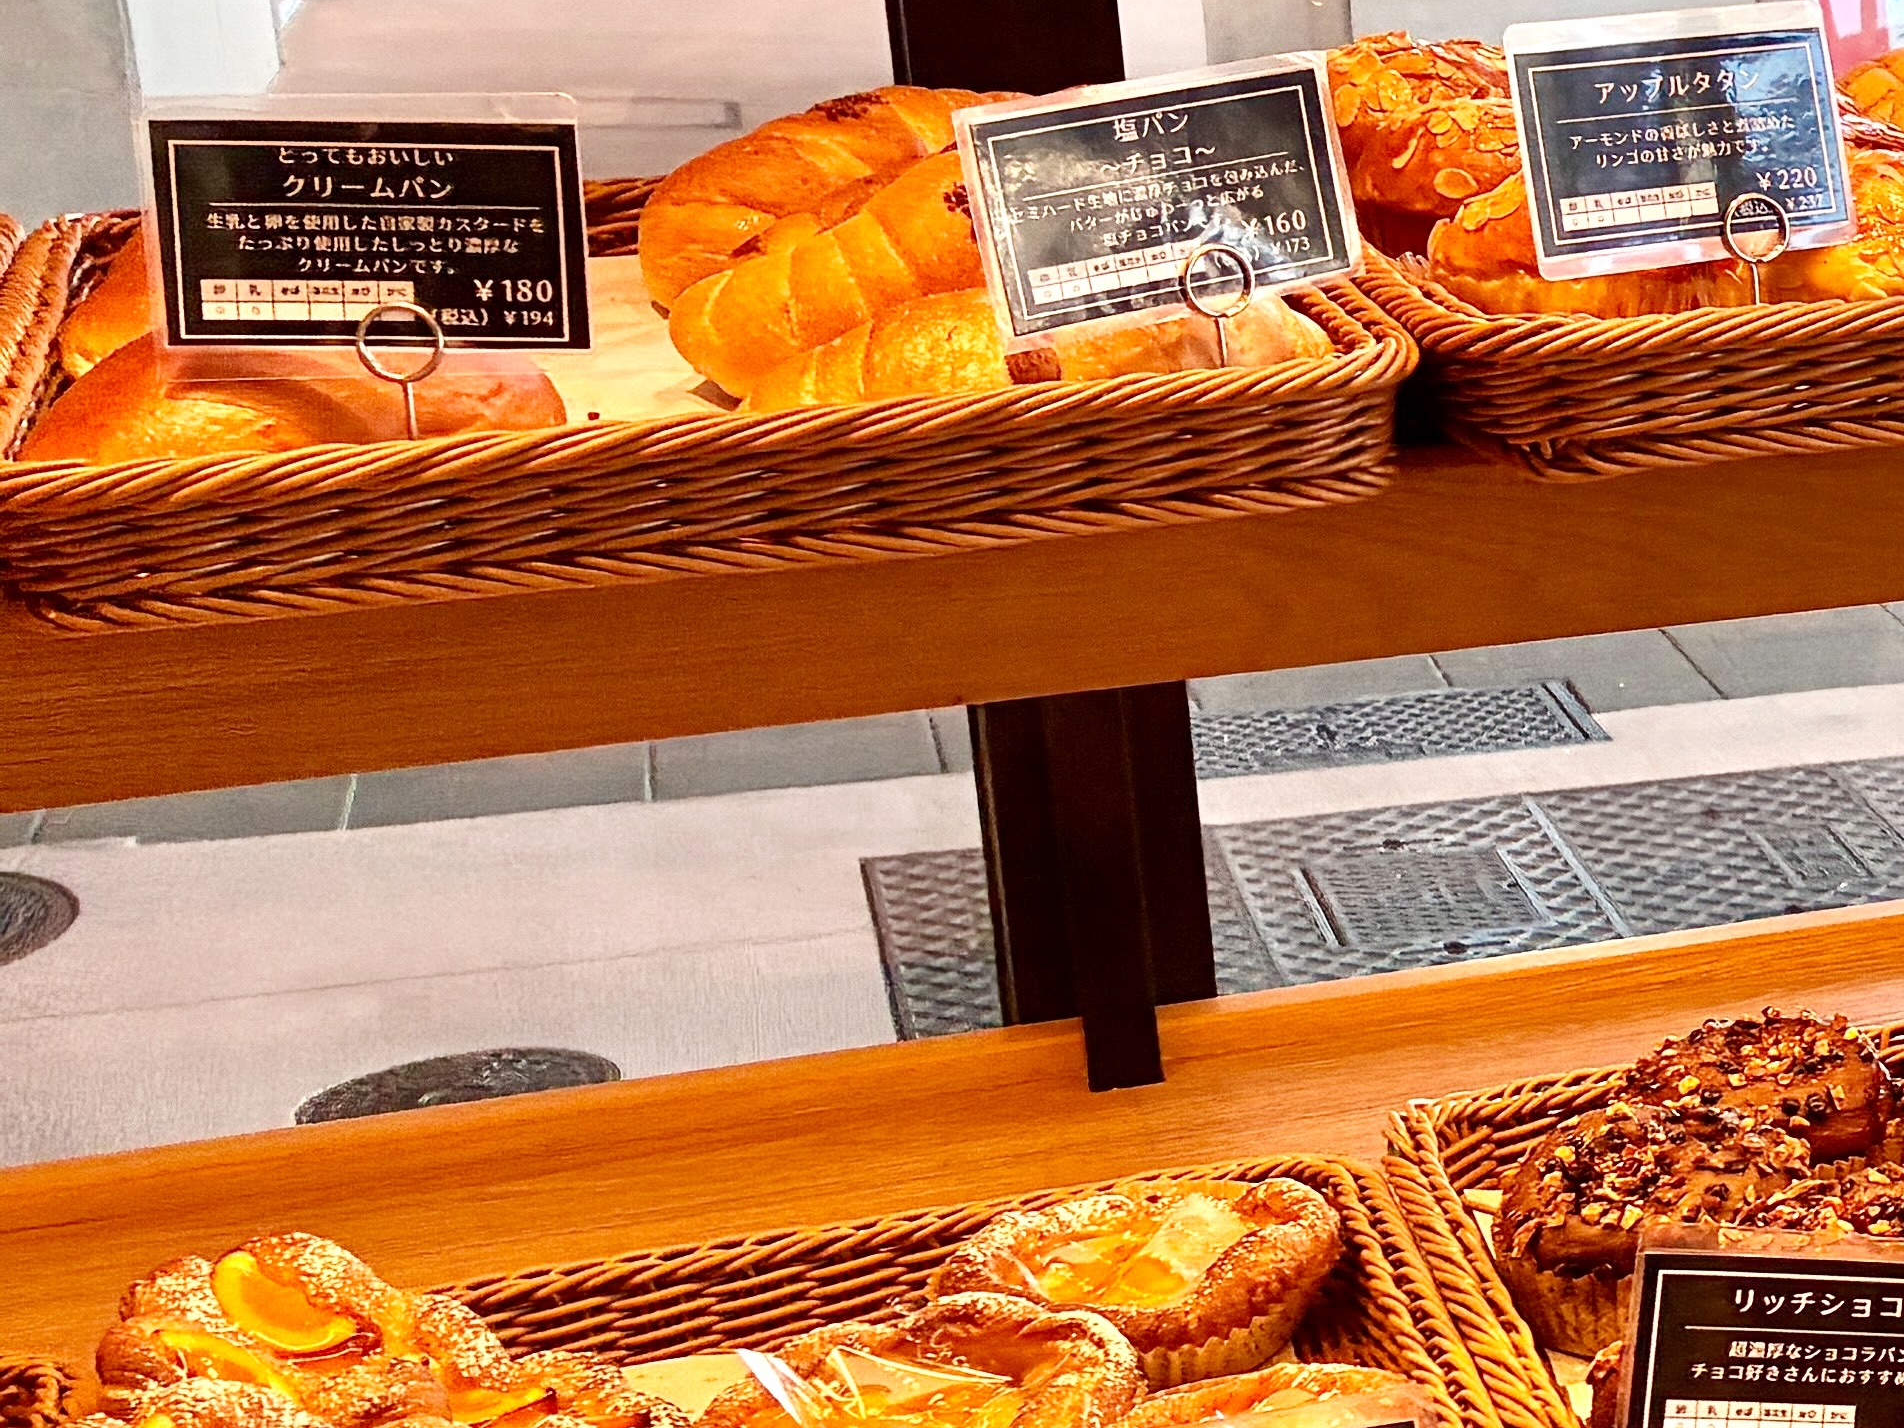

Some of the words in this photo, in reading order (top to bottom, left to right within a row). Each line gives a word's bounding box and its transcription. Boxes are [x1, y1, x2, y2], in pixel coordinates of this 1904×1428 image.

[1594, 69, 1760, 105] アップルタタン
[1112, 112, 1190, 143] 塩パン
[277, 147, 454, 167] とってもおいしい
[282, 174, 454, 201] クリームパン
[1757, 166, 1818, 192] ¥220
[1785, 194, 1823, 211] ¥237
[206, 212, 545, 234] 生乳と卵を使用した自家製カスタードを
[1242, 209, 1307, 242] ¥160
[238, 236, 520, 255] たっぷり使用したしっとり濃厚な
[298, 258, 456, 275] クリームパンです。
[473, 279, 554, 303] ¥180
[503, 310, 554, 327] ¥194
